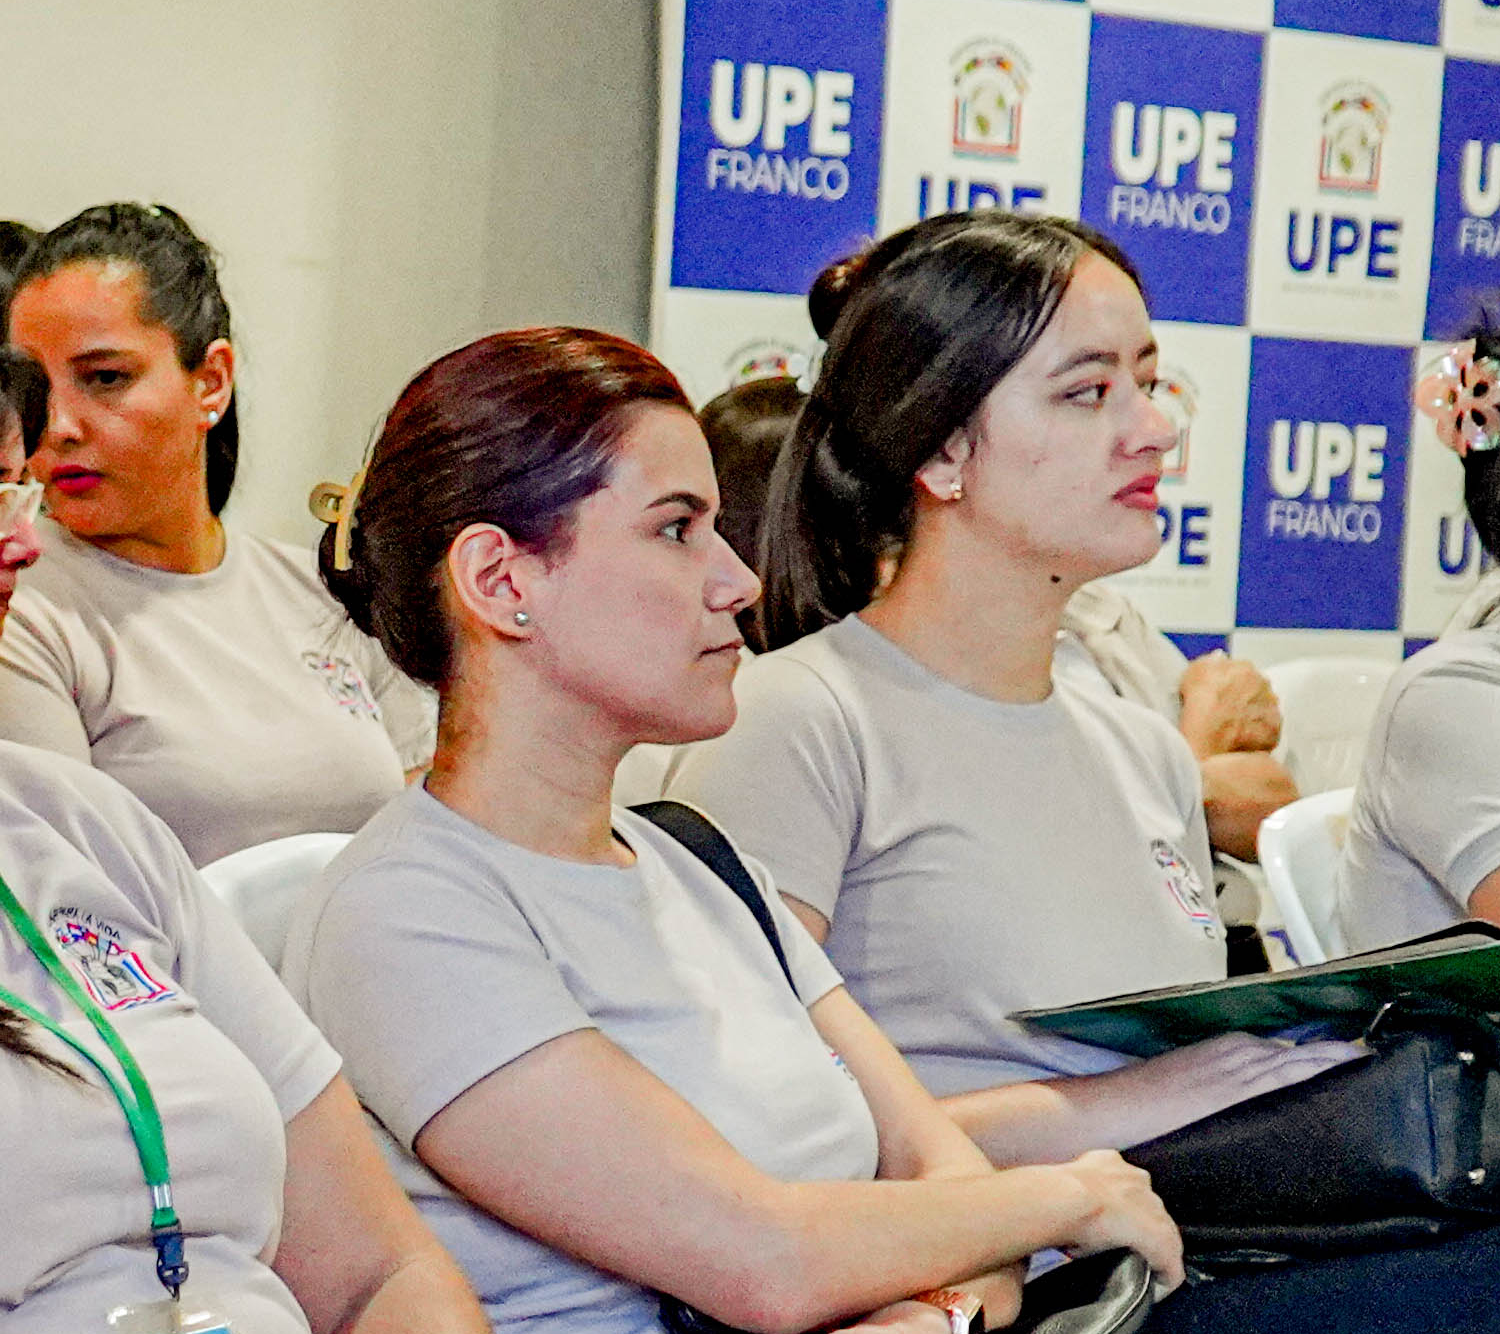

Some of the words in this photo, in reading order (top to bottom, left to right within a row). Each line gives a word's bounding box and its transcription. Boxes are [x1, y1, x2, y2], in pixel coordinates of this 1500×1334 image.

[709, 58, 855, 157] UPE
[706, 148, 849, 201] FRANCO
[1111, 100, 1238, 194] UPE
[1109, 185, 1232, 234] FRANCO
[1287, 210, 1402, 279] UPE
[1269, 419, 1389, 502] UPE
[1266, 500, 1383, 543] FRANCO
